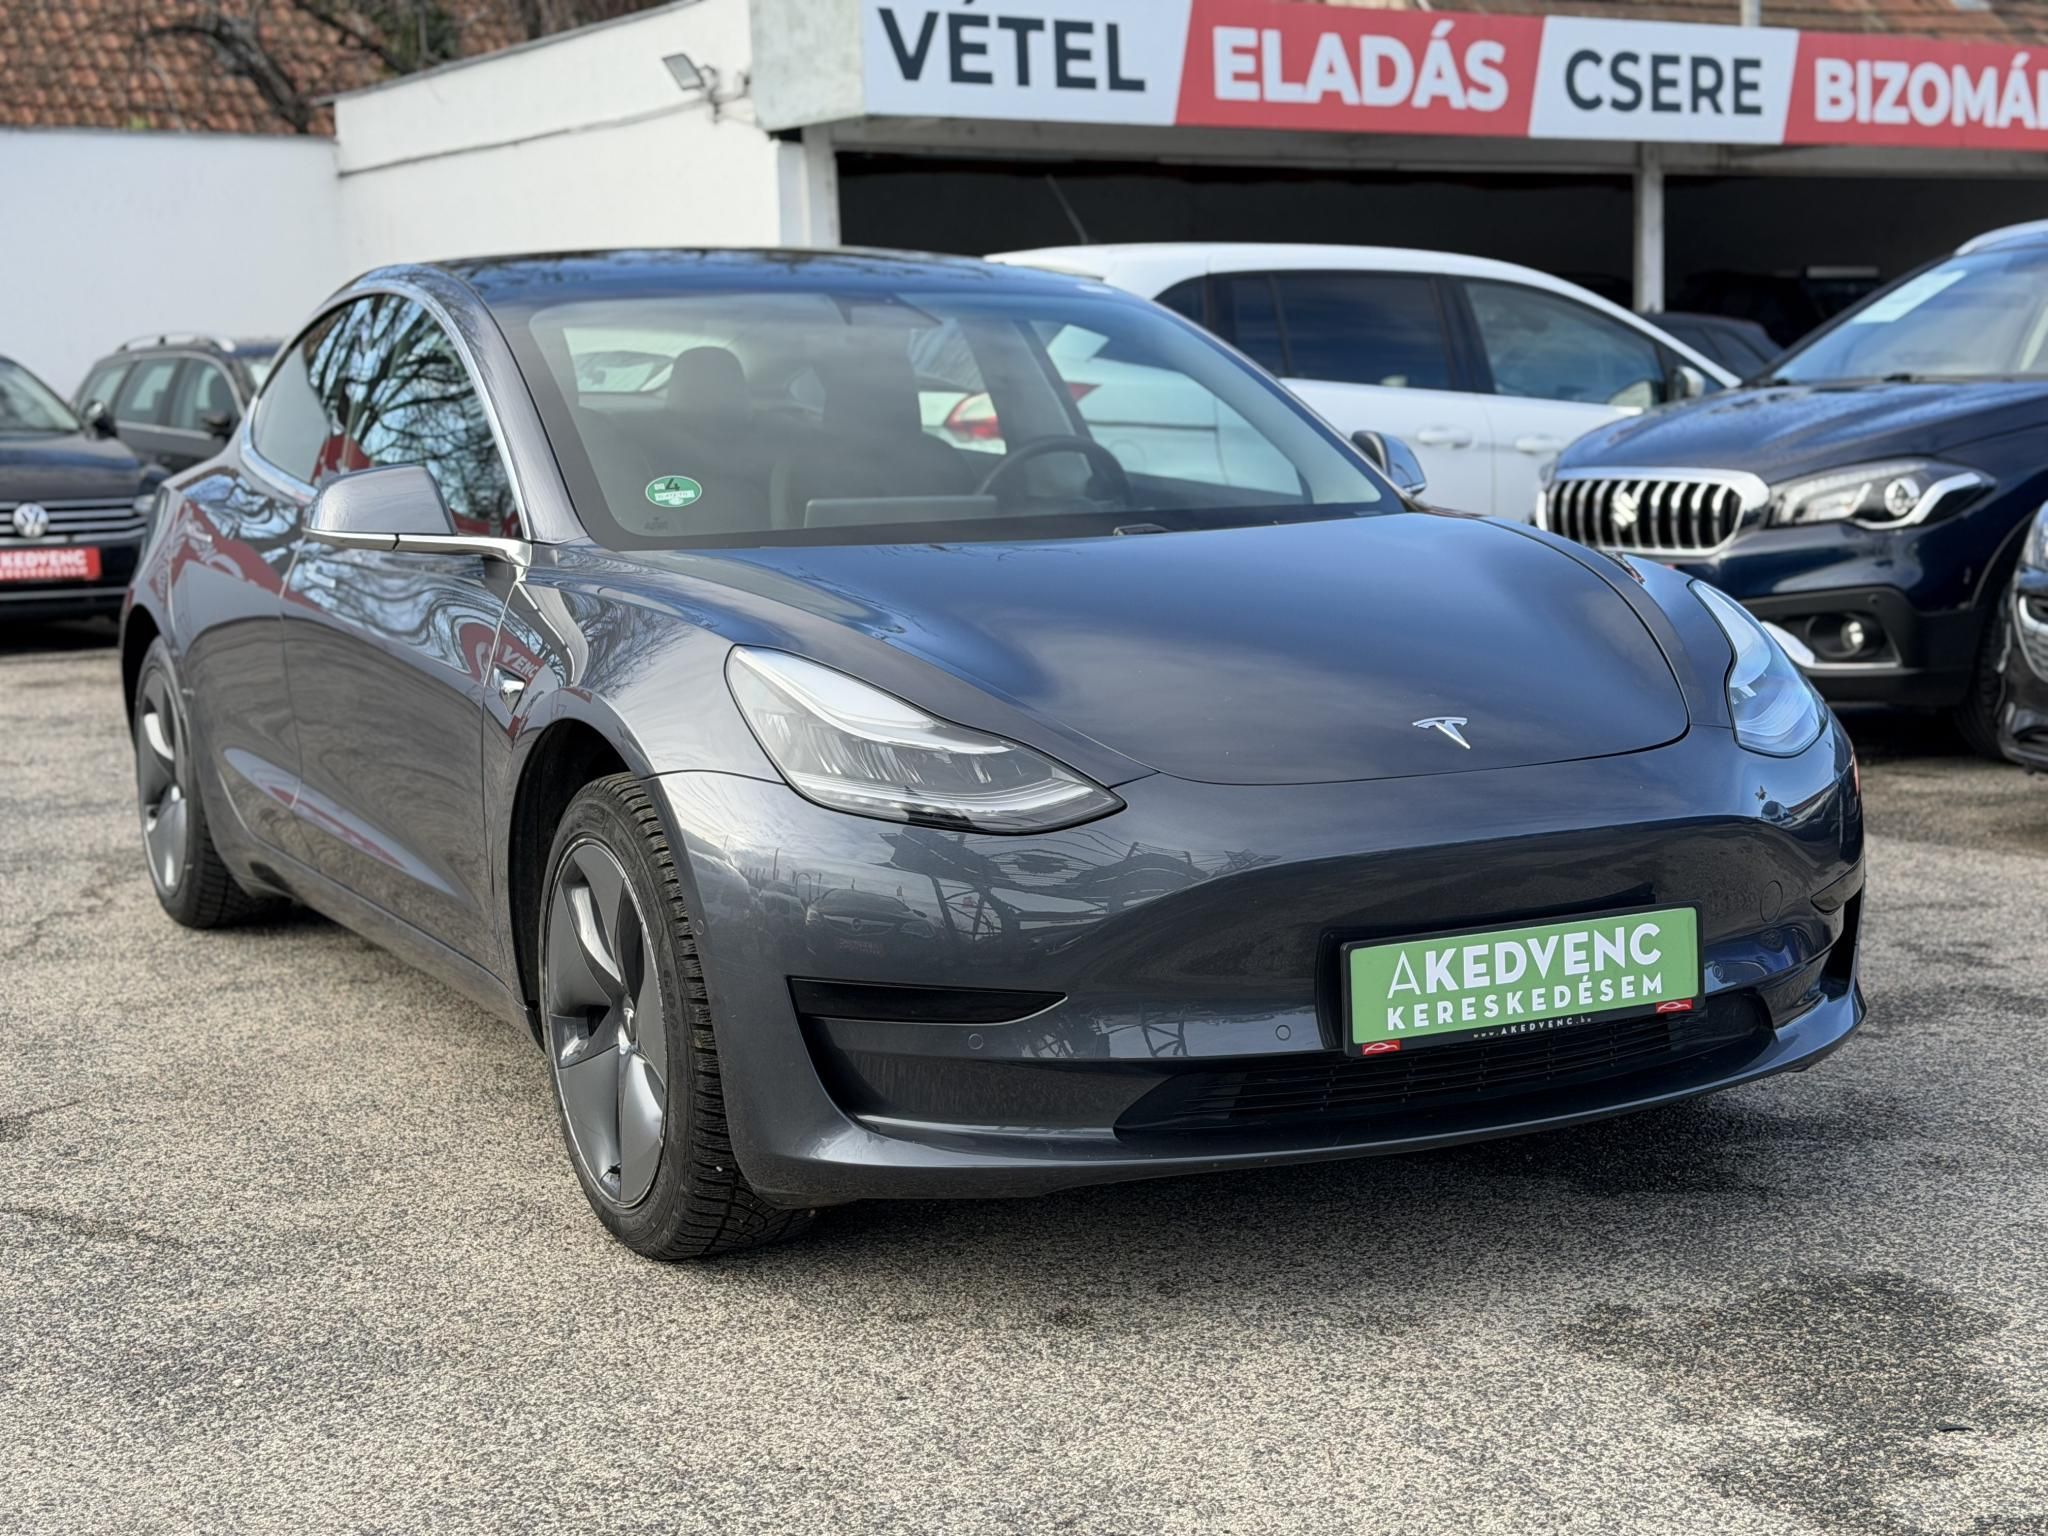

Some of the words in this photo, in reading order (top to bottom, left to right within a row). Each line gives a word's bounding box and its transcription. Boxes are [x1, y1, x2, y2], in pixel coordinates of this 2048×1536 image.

[877, 0, 1147, 93] VÉTEL
[1212, 20, 1509, 112] ELADÁS
[1565, 49, 1763, 115] CSERE
[1387, 922, 1662, 999] AKEDVENC
[1387, 972, 1663, 1031] KERESKEDÉSEM
